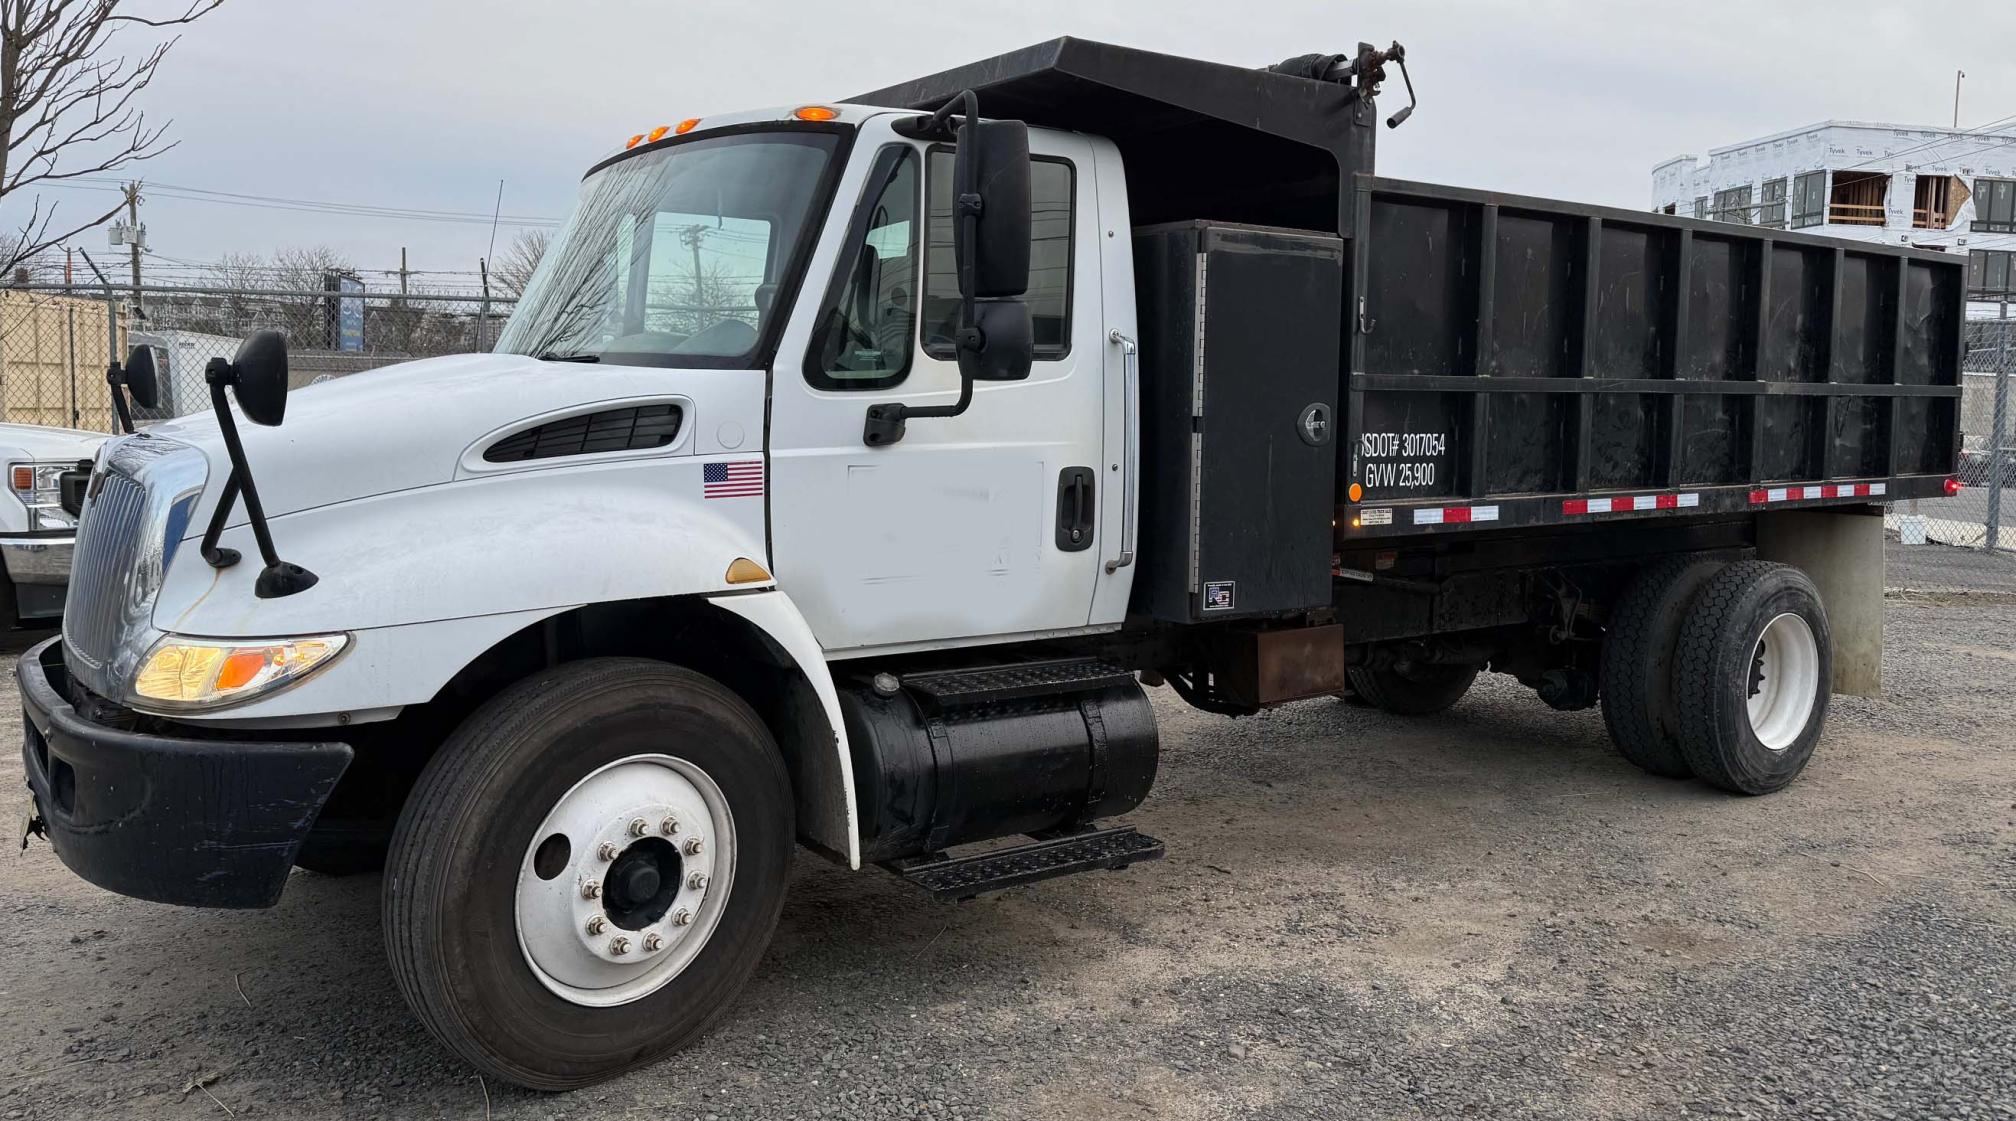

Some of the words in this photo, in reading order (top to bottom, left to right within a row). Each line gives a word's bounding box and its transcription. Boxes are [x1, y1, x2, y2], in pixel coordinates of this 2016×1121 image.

[1888, 207, 1904, 215] Tyvek
[1402, 433, 1446, 457] 3017054
[1365, 463, 1397, 488] GVW
[1399, 462, 1435, 490] 25,900
